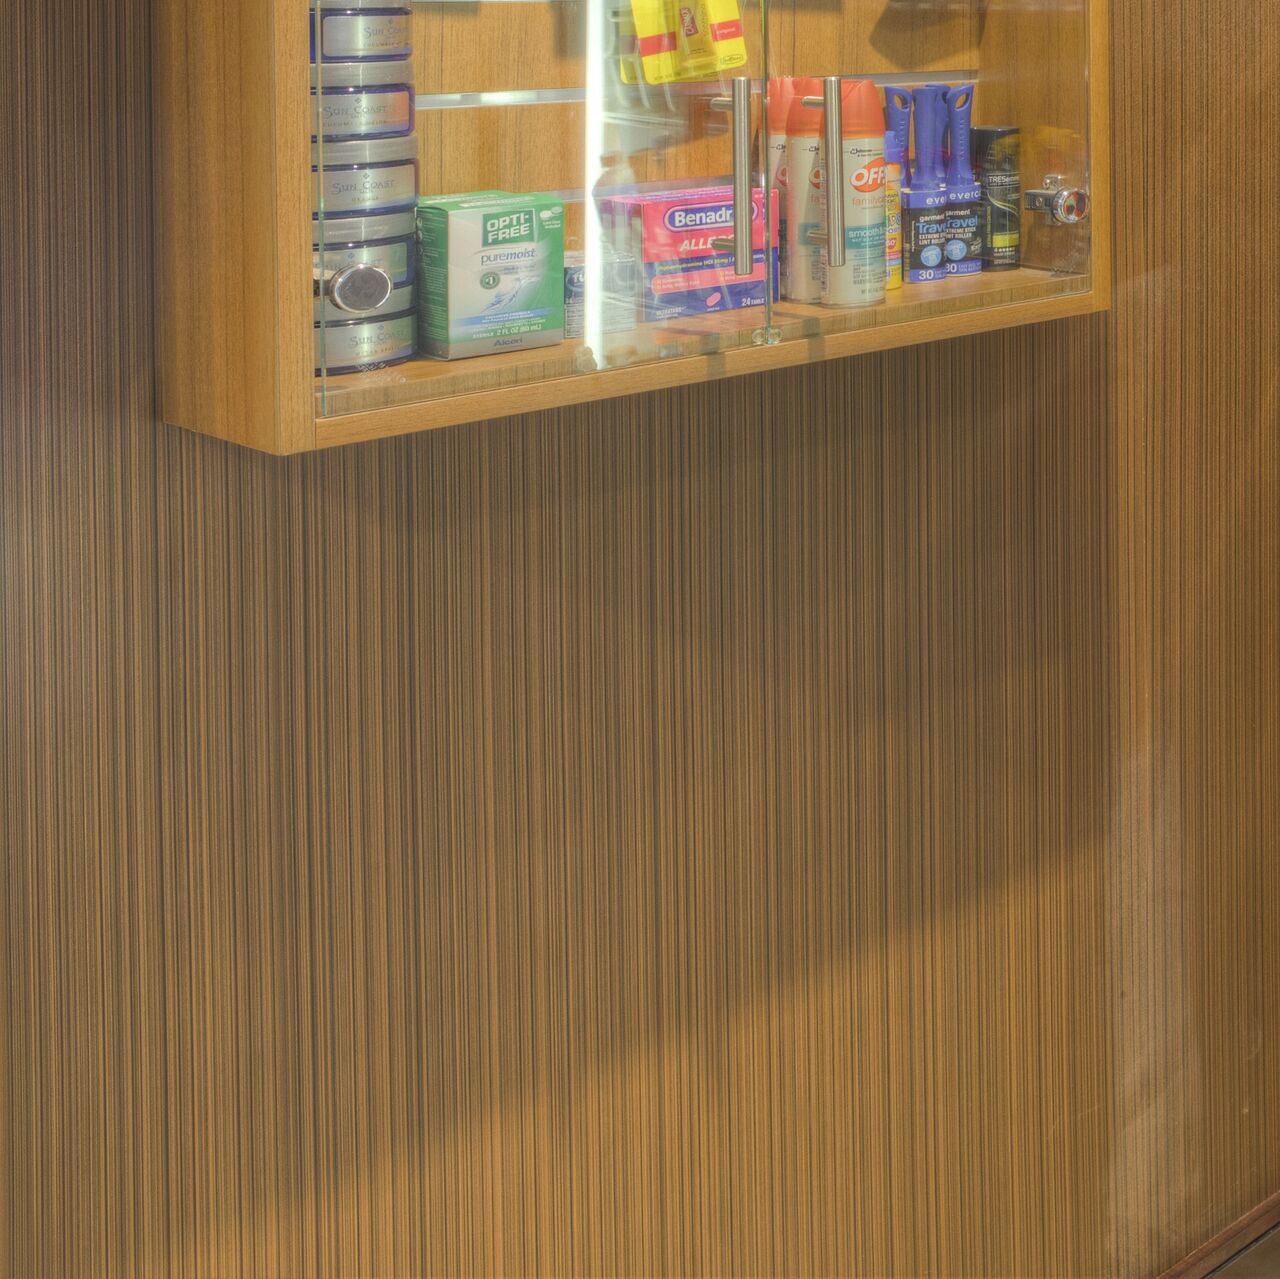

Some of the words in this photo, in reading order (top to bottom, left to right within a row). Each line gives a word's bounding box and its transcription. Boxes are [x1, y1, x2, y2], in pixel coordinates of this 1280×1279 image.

[850, 166, 886, 187] OFF!
[332, 182, 361, 195] SUN
[362, 179, 395, 190] COAST
[486, 213, 529, 232] OPTI-
[487, 224, 530, 244] FREE
[480, 247, 537, 266] puremoist
[918, 269, 934, 281] 30
[493, 337, 523, 347] Alcon
